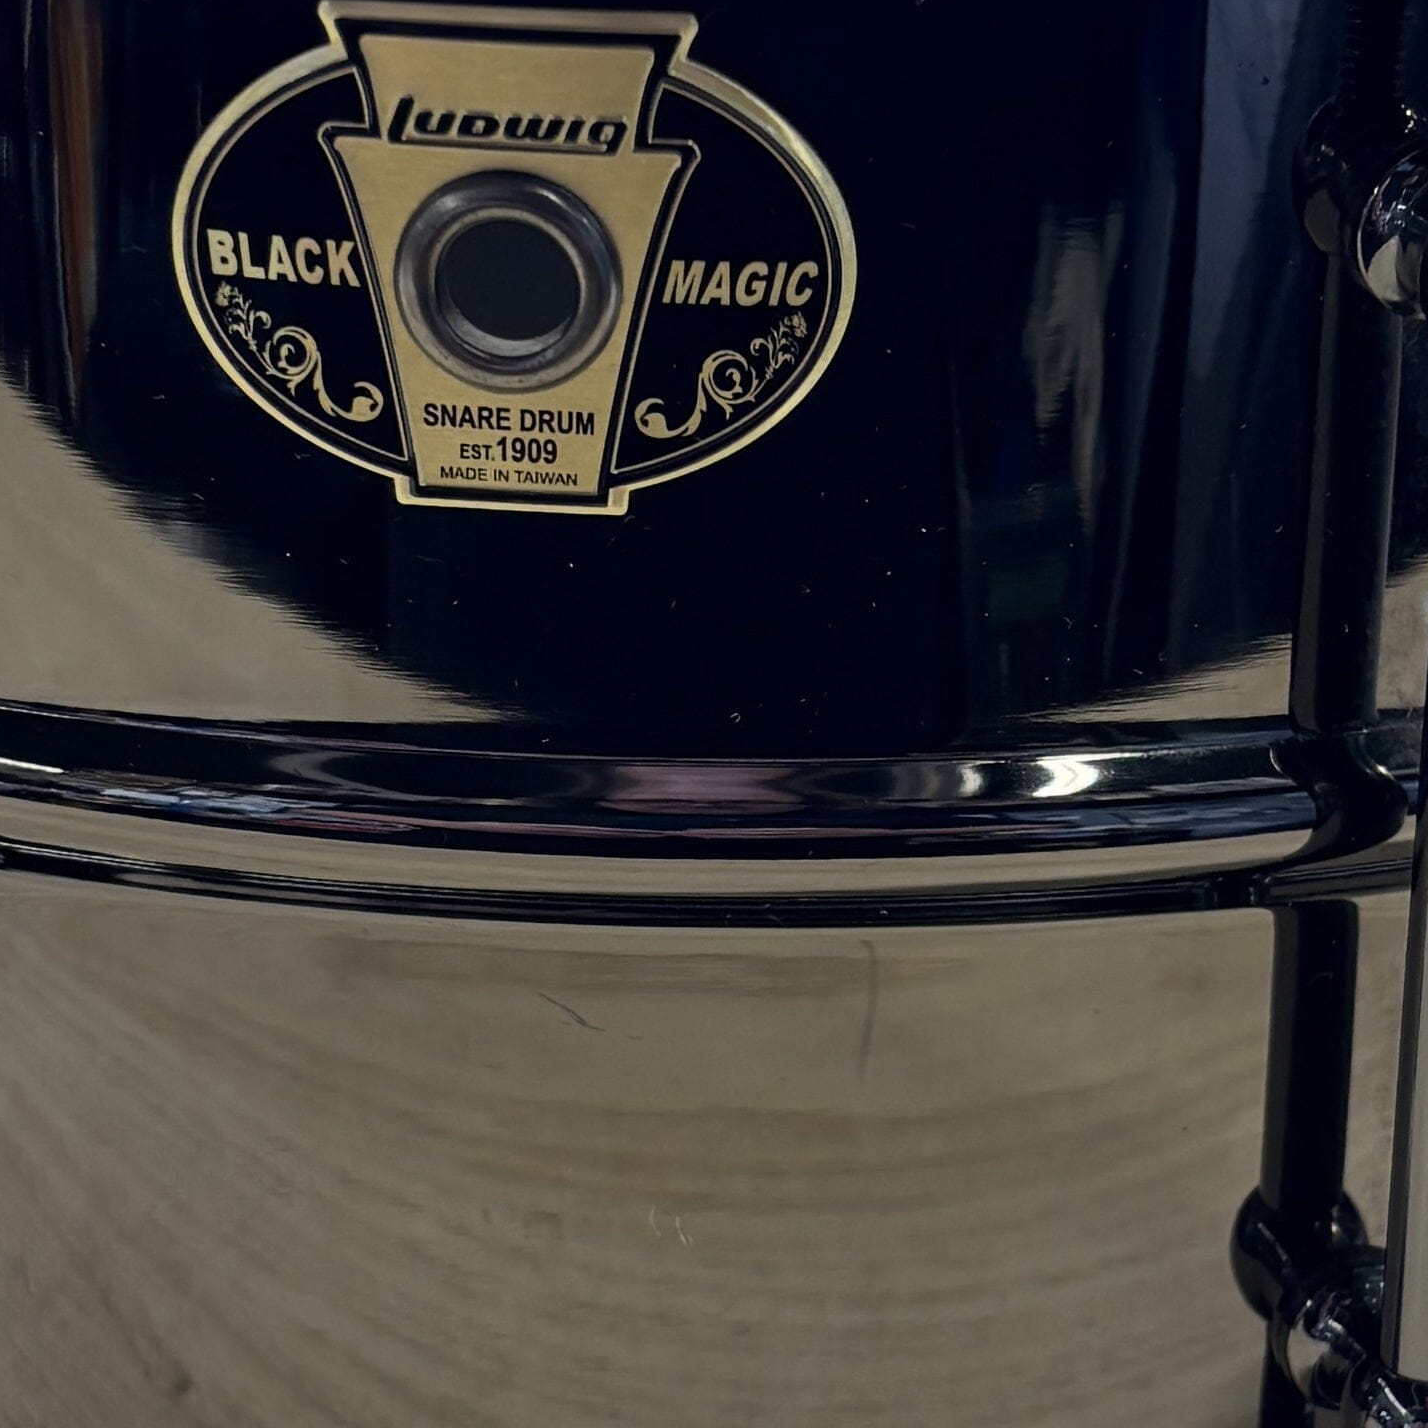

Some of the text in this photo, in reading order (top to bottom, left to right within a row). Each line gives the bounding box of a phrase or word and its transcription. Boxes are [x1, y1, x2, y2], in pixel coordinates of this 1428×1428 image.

[206, 228, 819, 307] BLACK MAGIC
[422, 402, 595, 436] SNARE DRUM
[439, 465, 578, 487] MADE IN TAIWAN
